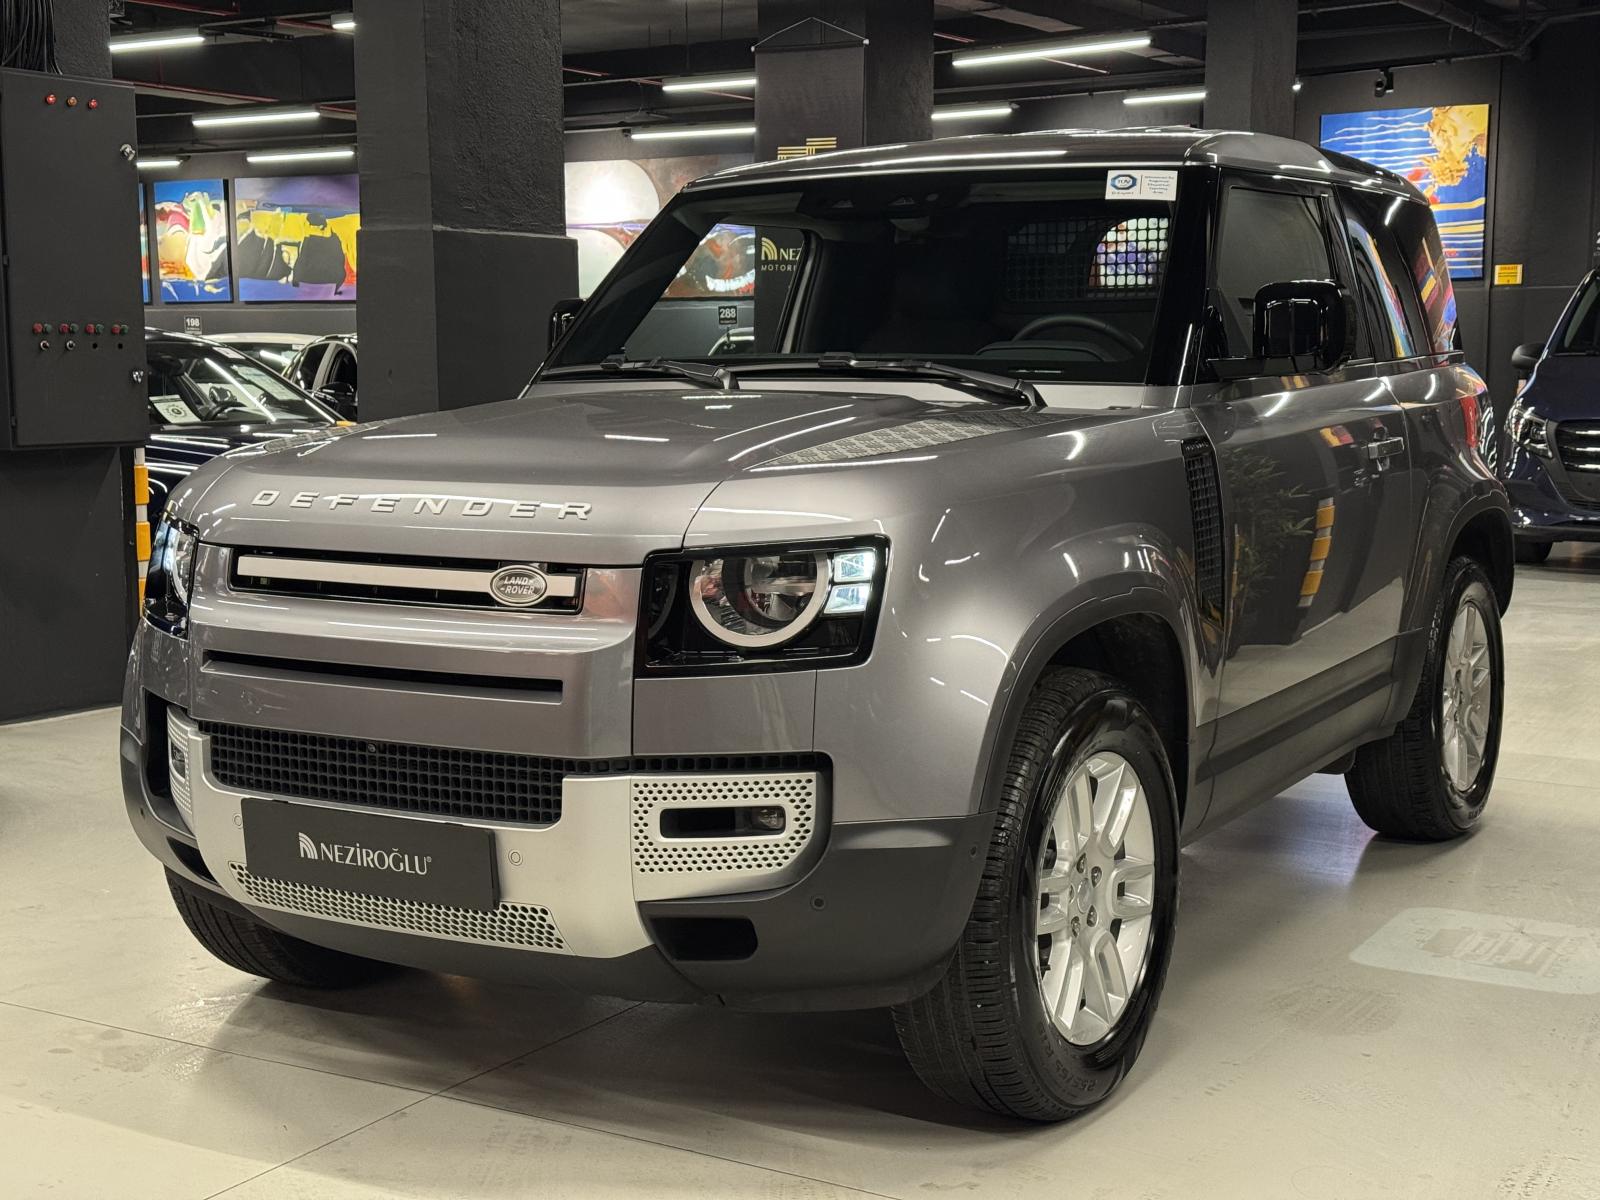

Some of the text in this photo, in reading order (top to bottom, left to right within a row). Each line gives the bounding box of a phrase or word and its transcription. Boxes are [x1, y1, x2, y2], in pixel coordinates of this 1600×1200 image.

[720, 308, 736, 318] 288
[251, 489, 592, 521] DEFENDER
[504, 576, 529, 585] LAND
[505, 585, 535, 595] ROVER
[320, 842, 428, 876] NEZİROĞLU
